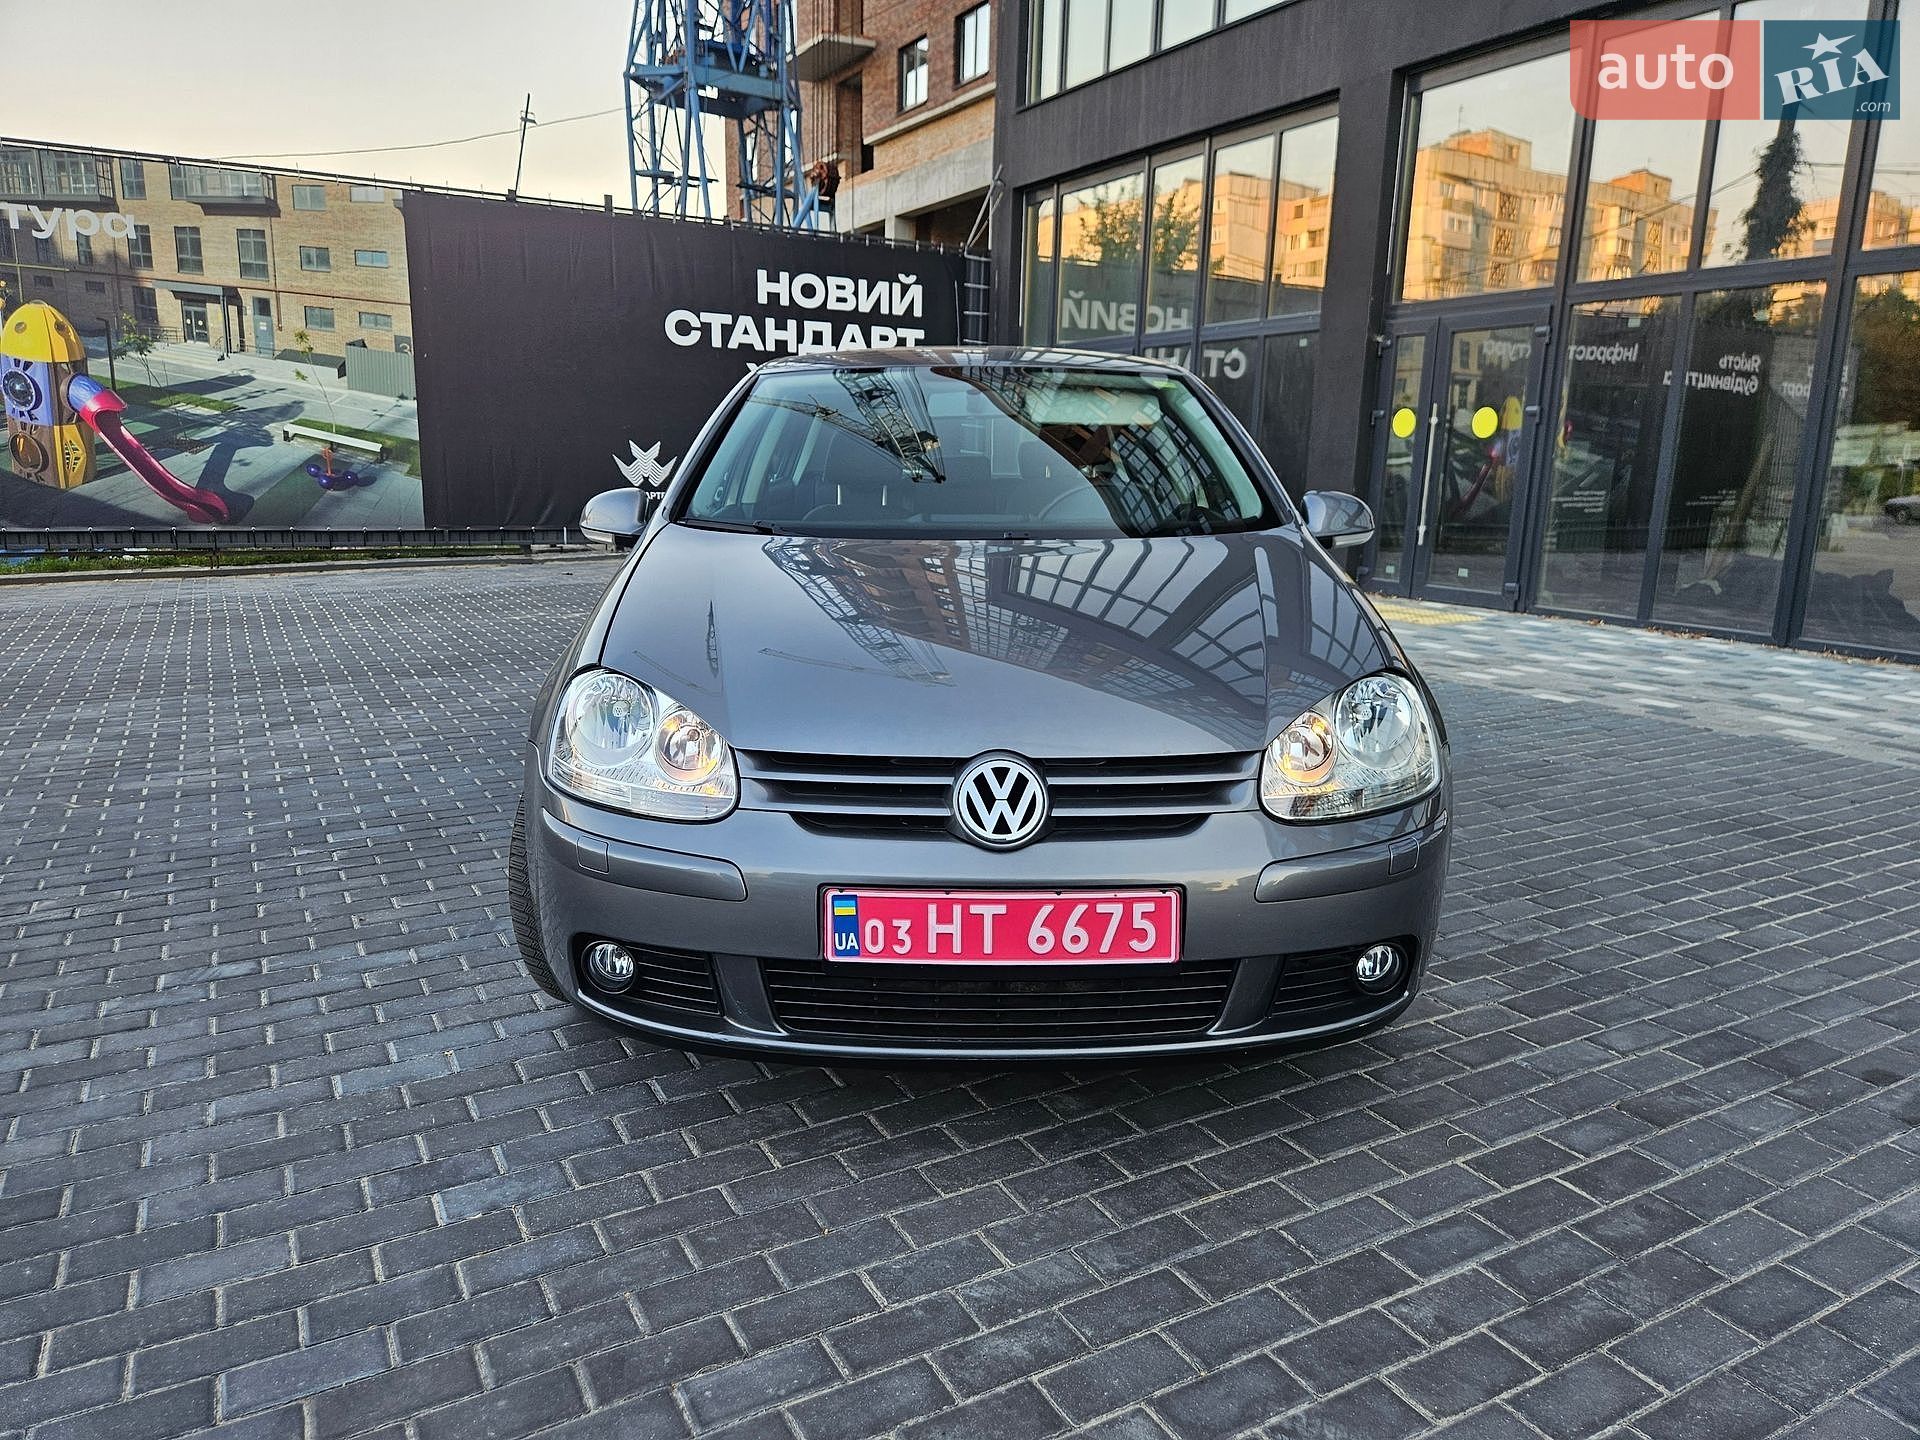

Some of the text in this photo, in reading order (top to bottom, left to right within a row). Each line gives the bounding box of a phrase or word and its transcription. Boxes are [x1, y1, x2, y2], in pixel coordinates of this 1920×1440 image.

[0, 201, 137, 240] тура
[756, 269, 923, 318] НОВИЙ
[956, 760, 1045, 842] VW
[834, 931, 859, 951] UA
[864, 919, 912, 955] 03
[1027, 903, 1157, 955] 6675
